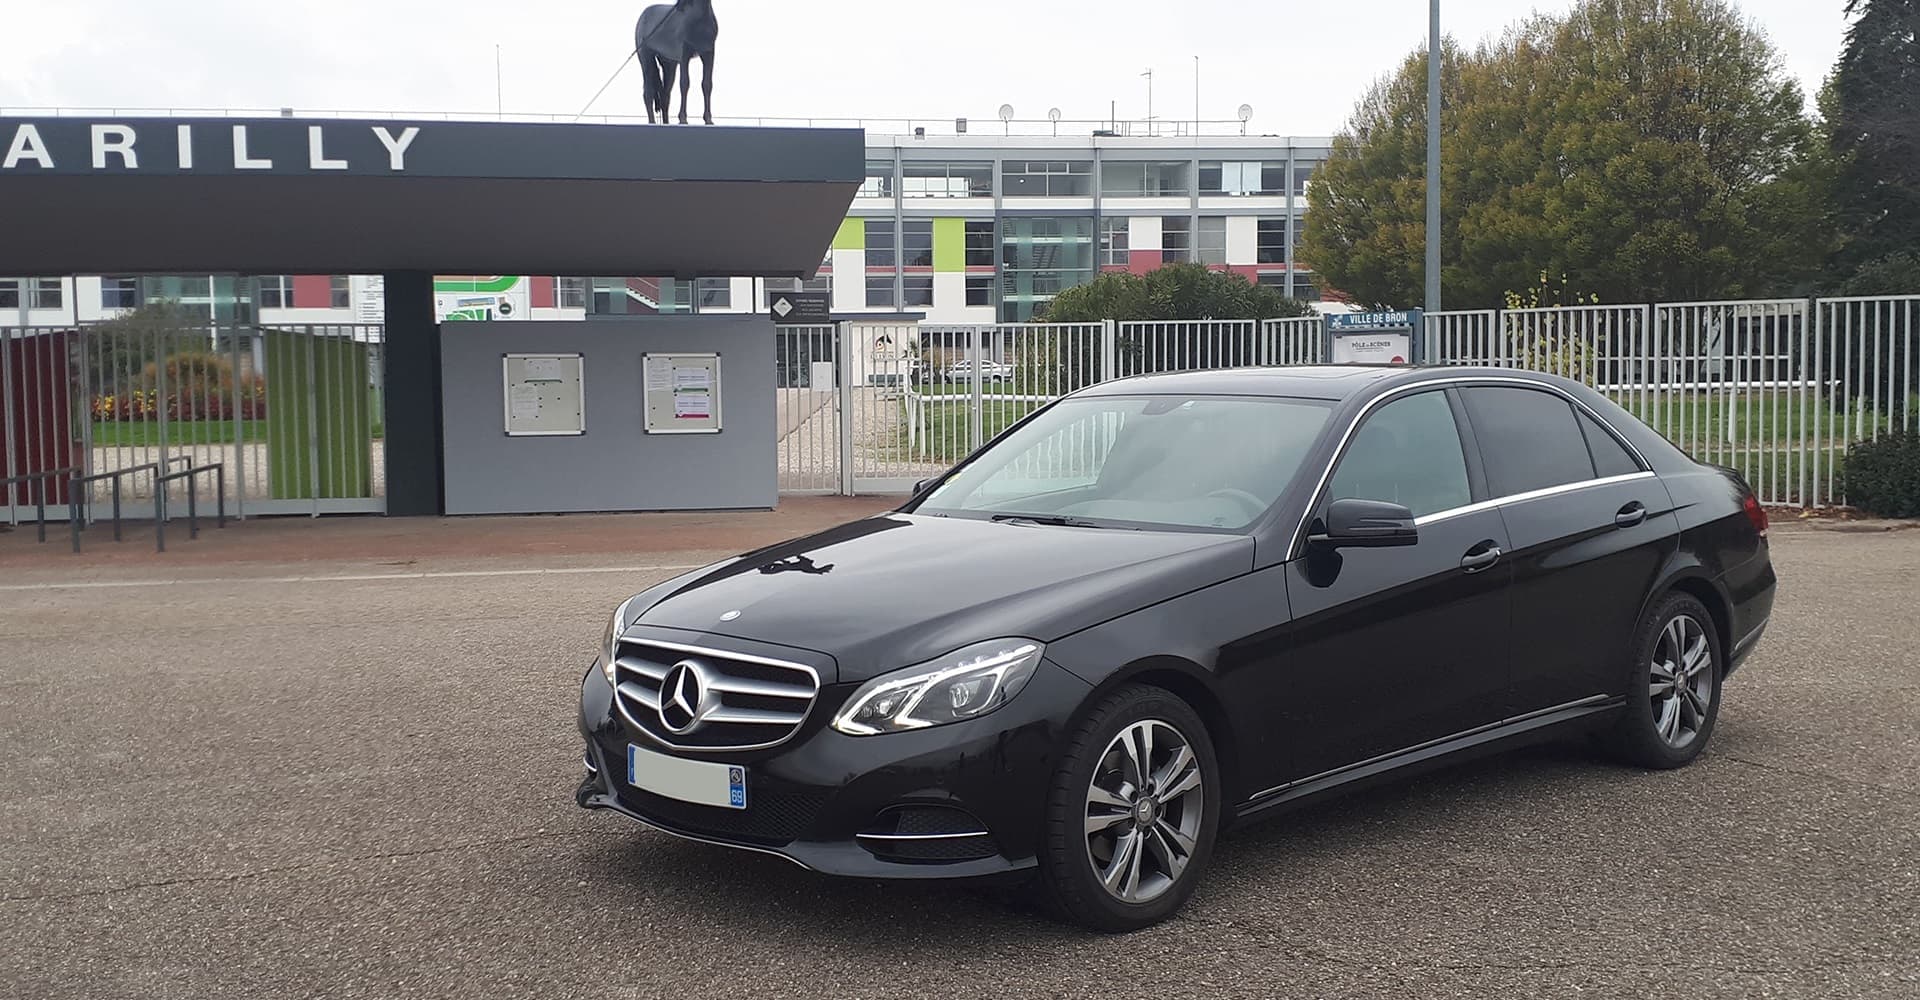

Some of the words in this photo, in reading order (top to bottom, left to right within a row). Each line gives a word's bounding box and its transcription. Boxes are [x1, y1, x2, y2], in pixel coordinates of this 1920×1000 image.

[3, 124, 419, 170] ARILLY
[1350, 314, 1371, 324] VILLE
[1373, 313, 1384, 323] DE
[1385, 312, 1407, 323] BRON
[731, 789, 743, 804] 69
